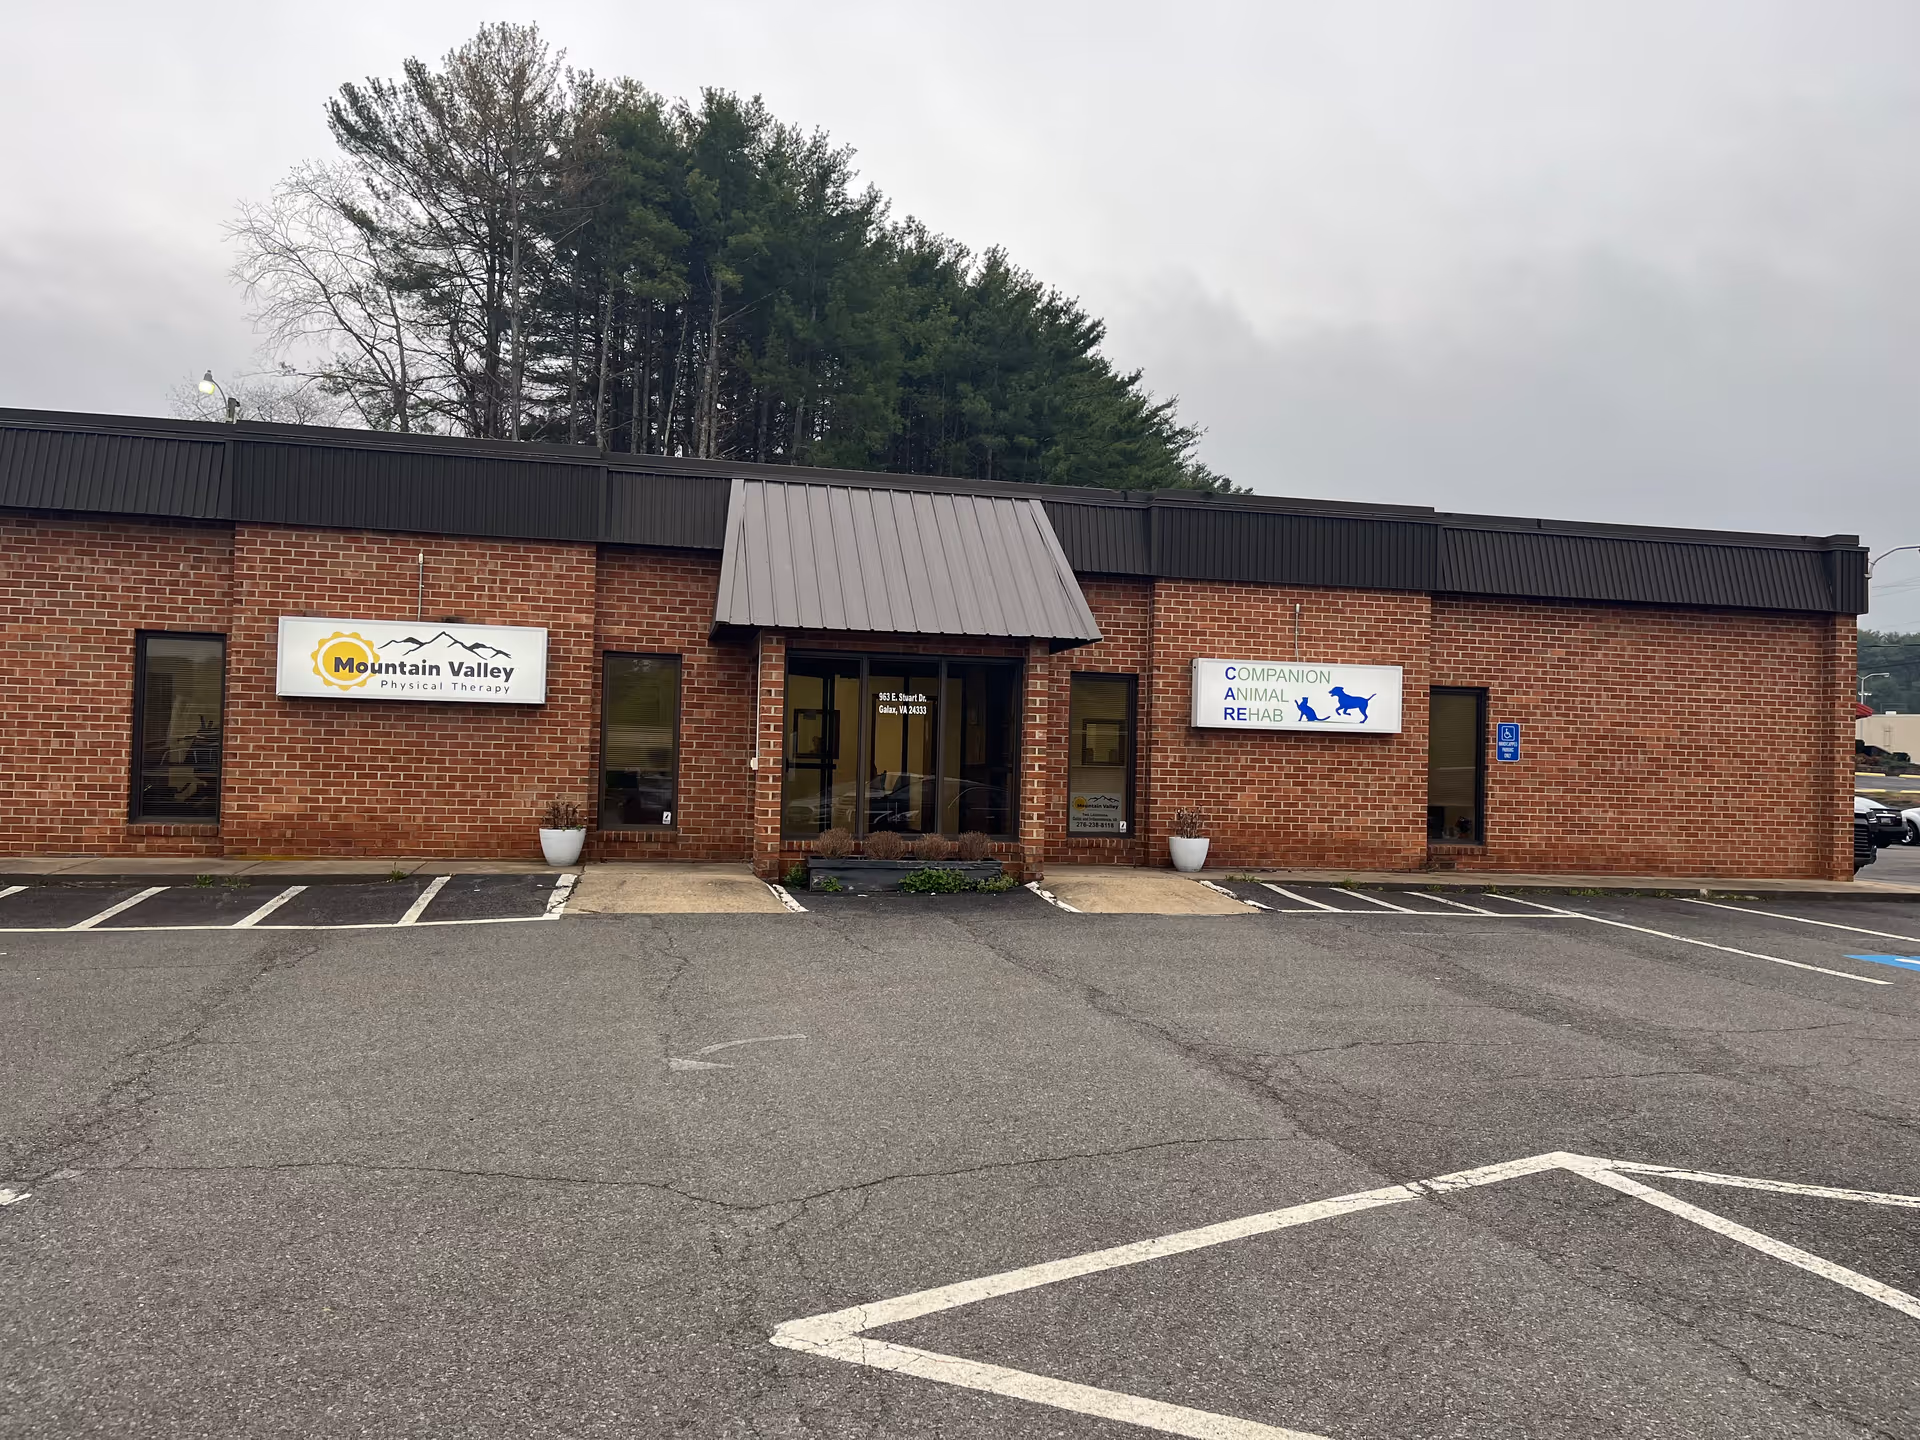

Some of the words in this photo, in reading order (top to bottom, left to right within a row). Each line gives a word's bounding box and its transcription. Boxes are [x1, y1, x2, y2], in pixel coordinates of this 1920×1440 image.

[333, 656, 441, 677] Mountain
[448, 661, 515, 682] Valley
[1225, 666, 1331, 684] COMPANION
[380, 680, 443, 691] Physical
[452, 682, 510, 694] Therapy
[878, 692, 890, 701] 963
[891, 693, 898, 701] E.
[898, 693, 917, 702] Stuart
[918, 693, 927, 702] Dr.
[1224, 687, 1289, 703] ANIMAL
[878, 704, 898, 715] Galax,
[899, 705, 908, 714] VA
[908, 706, 927, 715] 24333
[1223, 707, 1284, 722] REHAB
